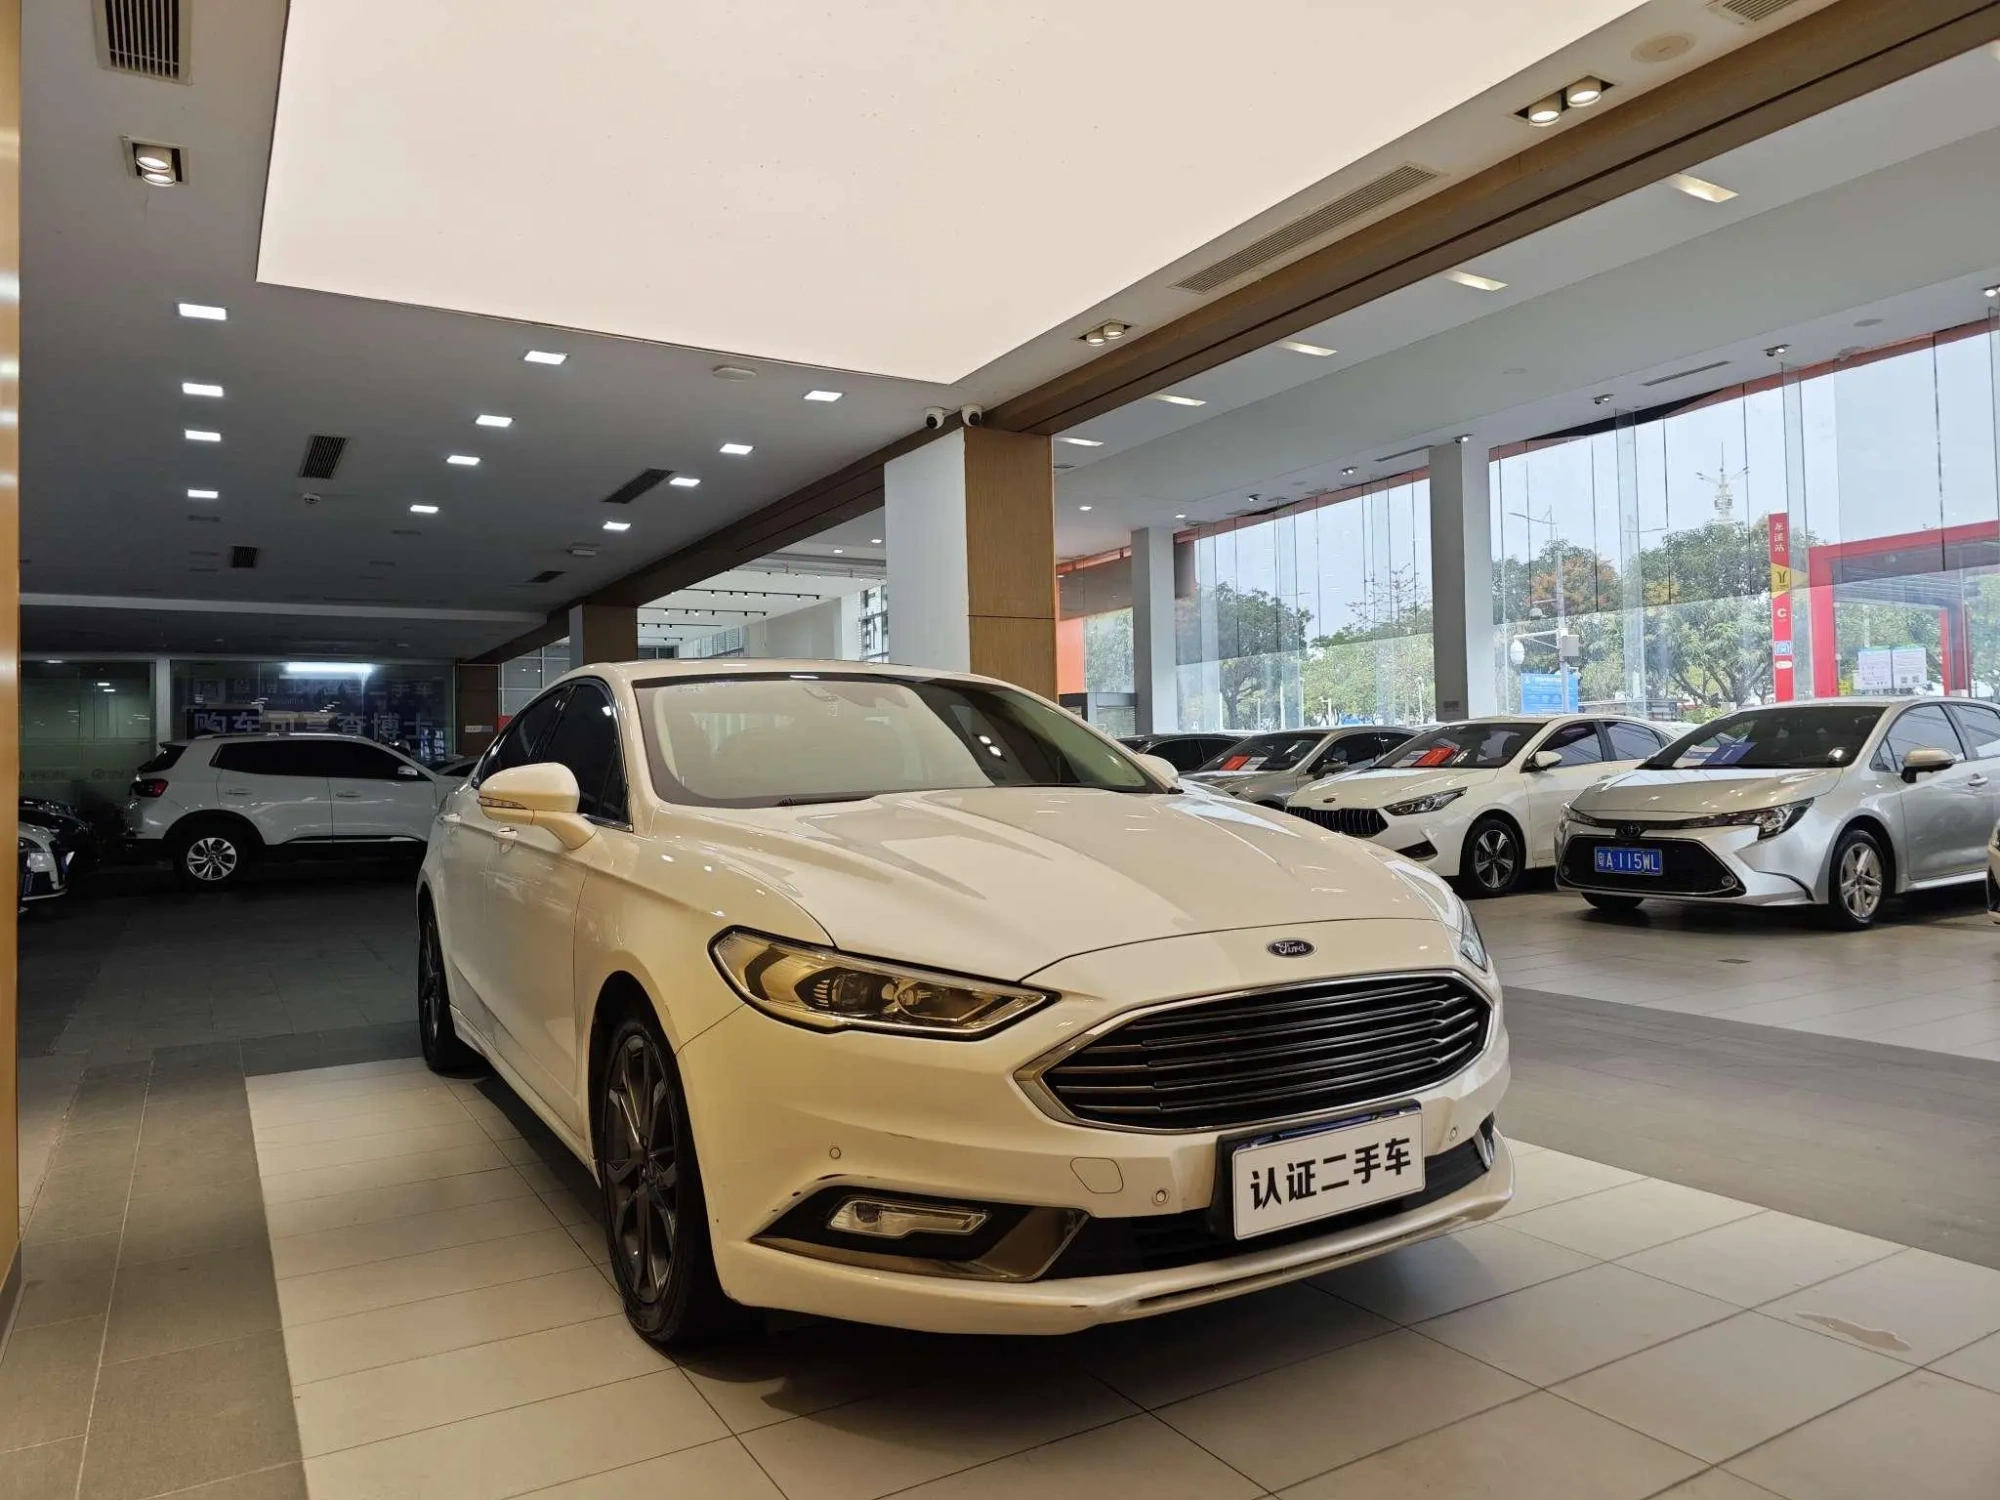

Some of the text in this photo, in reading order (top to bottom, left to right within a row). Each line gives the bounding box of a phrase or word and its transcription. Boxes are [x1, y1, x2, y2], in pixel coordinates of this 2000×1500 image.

[1777, 608, 1787, 618] C
[1275, 941, 1306, 954] Ford
[1250, 1137, 1412, 1211] 认证二手车
